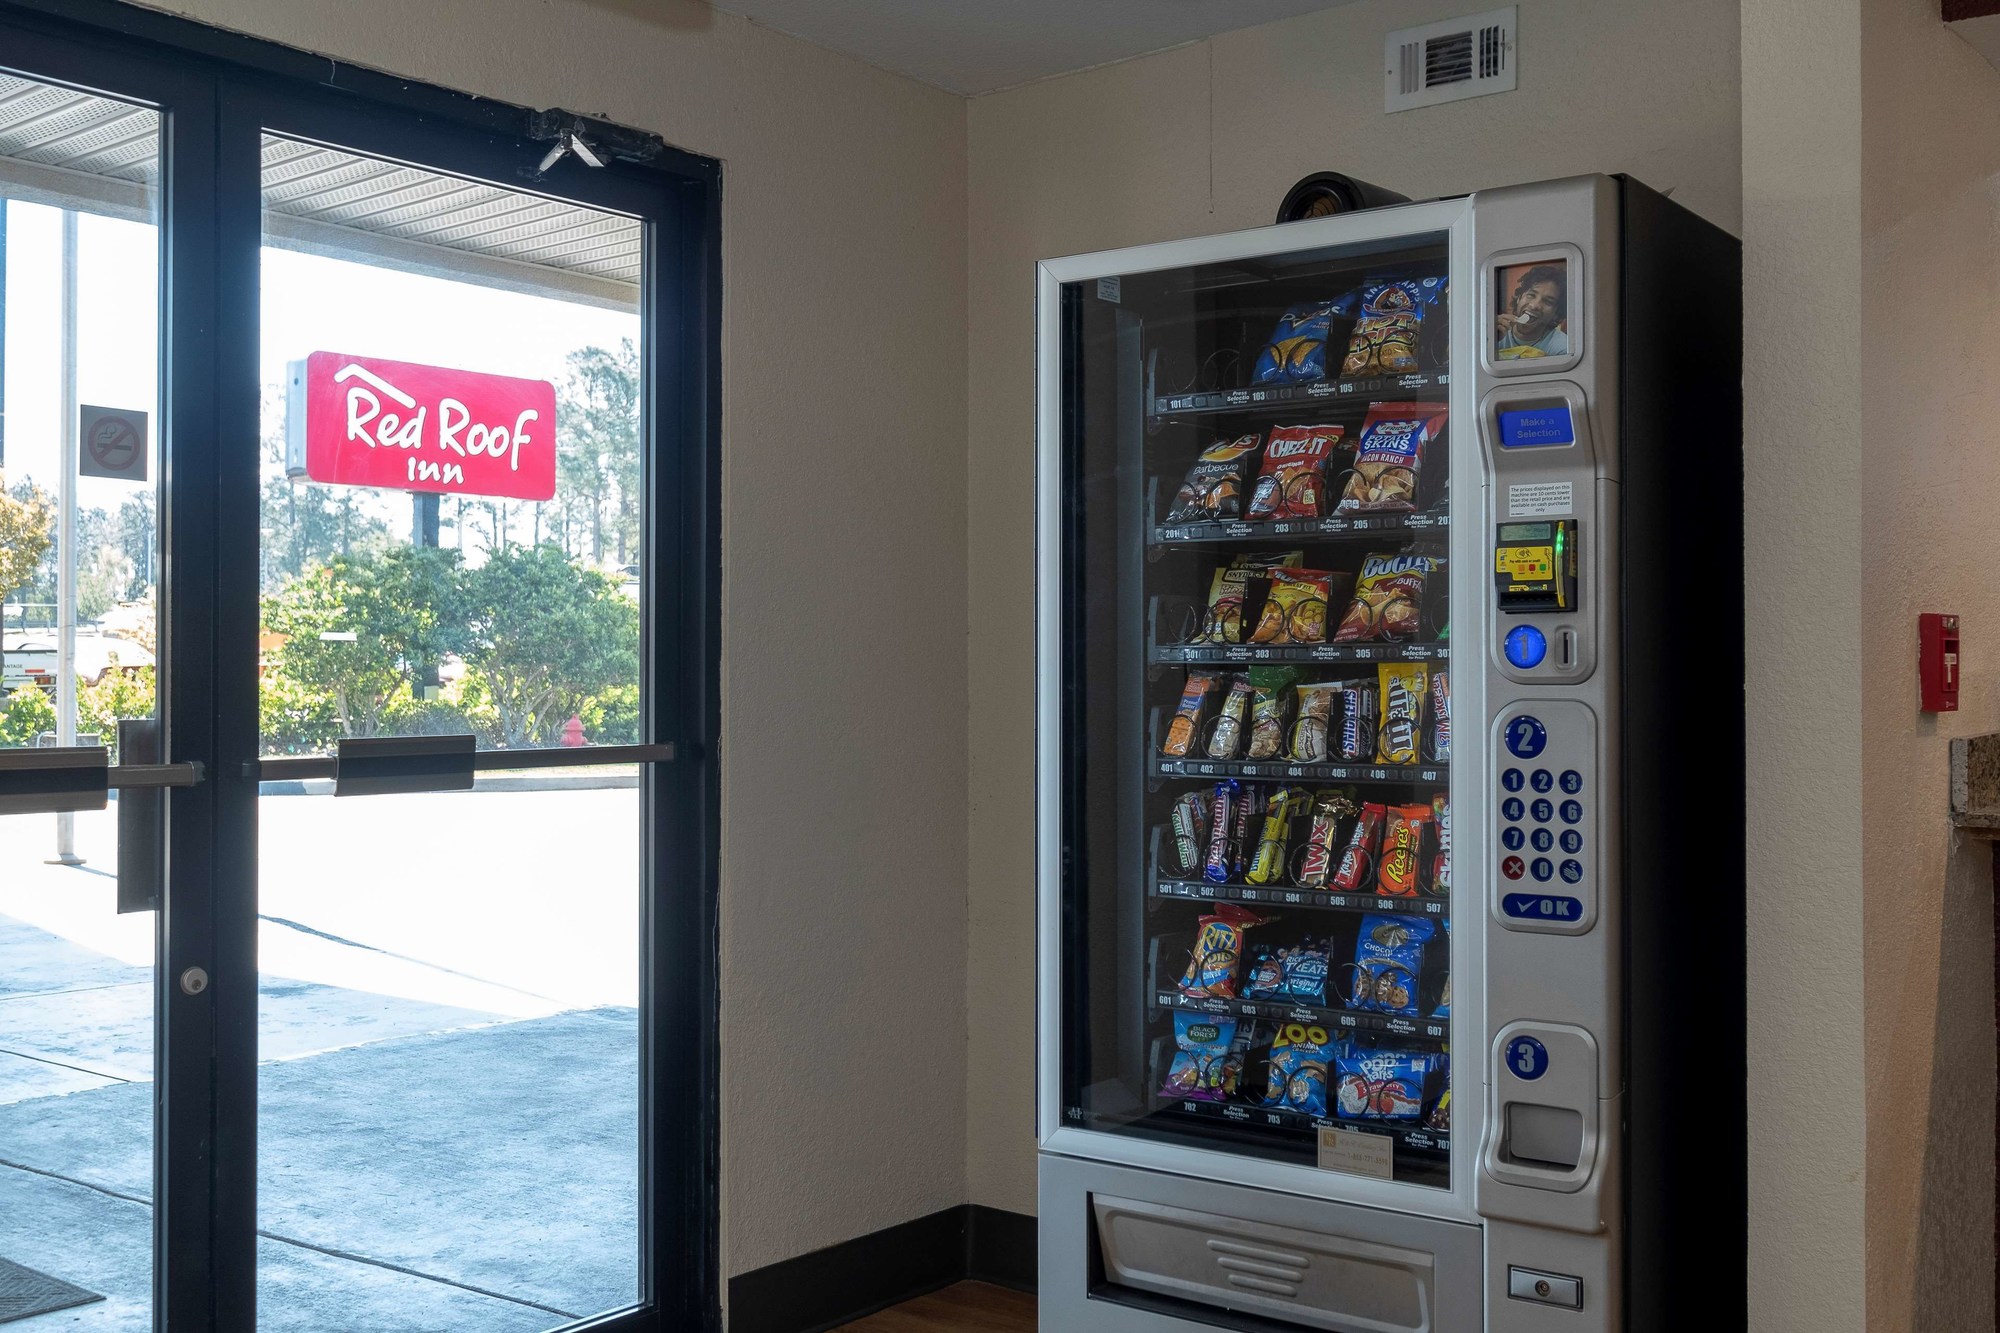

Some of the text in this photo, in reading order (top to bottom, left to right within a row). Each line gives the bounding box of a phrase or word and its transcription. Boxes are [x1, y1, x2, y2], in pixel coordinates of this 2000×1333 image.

[1356, 313, 1414, 333] HOT
[1340, 384, 1352, 392] 105
[1252, 392, 1265, 400] 103
[1170, 400, 1181, 408] 101
[1520, 418, 1546, 427] Make
[346, 386, 538, 471] Red Roof
[1368, 432, 1412, 441] POTATO
[1517, 429, 1560, 438] Selection
[1364, 438, 1409, 450] SKINS
[1380, 454, 1405, 464] RANCH
[1275, 524, 1289, 533] 203
[1354, 520, 1368, 529] 205
[1166, 530, 1178, 538] 201
[1517, 633, 1528, 660] 1
[1186, 650, 1198, 659] 301
[1255, 650, 1269, 658] 303
[1356, 649, 1370, 658] 305
[1343, 689, 1357, 753] SNICKERS
[1518, 723, 1533, 751] 2
[1161, 764, 1172, 772] 401
[1200, 765, 1213, 773] 402
[1243, 766, 1256, 775] 403
[1288, 768, 1302, 776] 404
[1332, 769, 1346, 778] 405
[1371, 770, 1385, 779] 406
[1422, 771, 1436, 780] 407
[1510, 773, 1577, 790] 1 2 3
[1510, 802, 1577, 820] 4 5 6
[1512, 831, 1577, 849] 7 8 9
[1300, 821, 1328, 881] TWIX
[1386, 828, 1409, 884] Reese's
[1540, 862, 1548, 877] 0
[1201, 887, 1214, 896] 502
[1242, 890, 1256, 899] 503
[1286, 893, 1300, 902] 504
[1331, 896, 1345, 906] 505
[1378, 900, 1393, 909] 506
[1427, 903, 1441, 912] 507
[1540, 899, 1569, 916] OK
[1203, 924, 1237, 950] RITZ
[1159, 996, 1171, 1004] 601
[1242, 1005, 1256, 1014] 603
[1341, 1016, 1356, 1026] 605
[1428, 1026, 1442, 1036] 607
[1518, 1044, 1535, 1072] 3
[1362, 1082, 1400, 1093] Srawerry
[1184, 1102, 1196, 1112] 702
[1268, 1114, 1280, 1124] 703
[1405, 1137, 1434, 1146] Selection
[1437, 1139, 1450, 1150] 707
